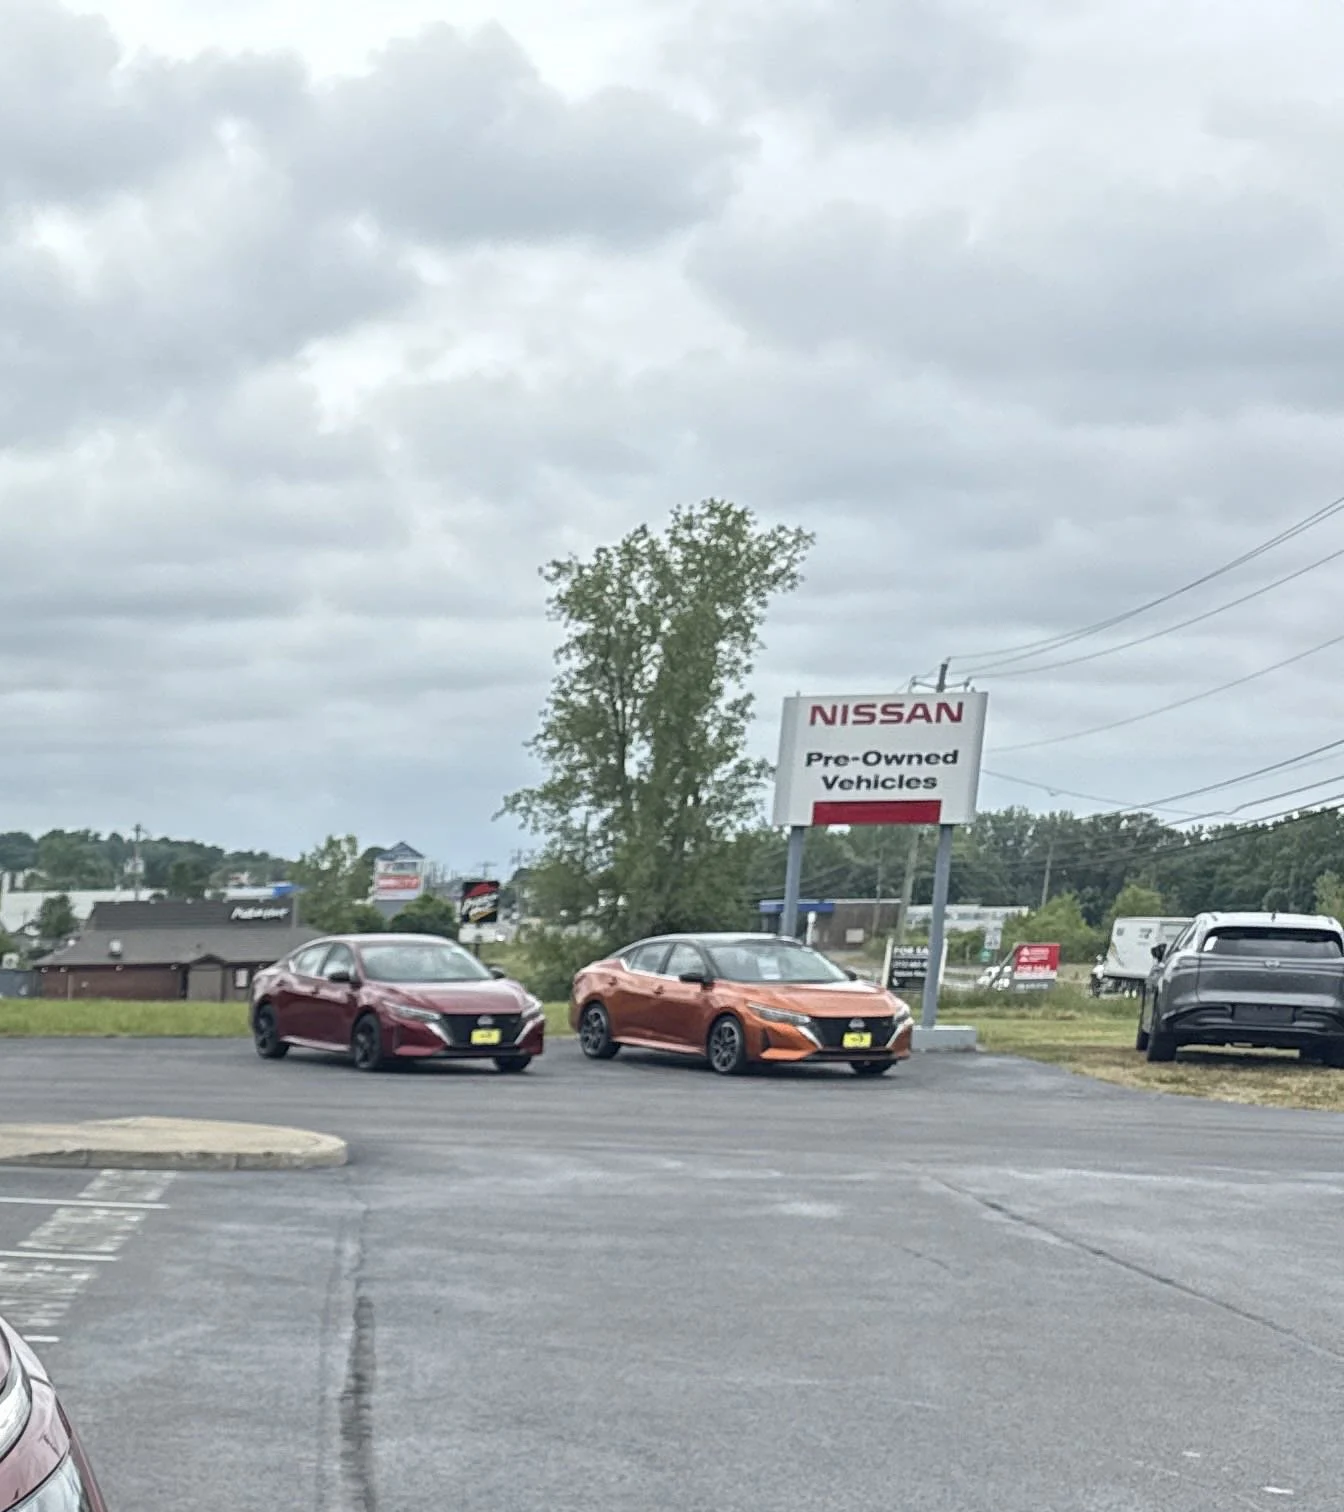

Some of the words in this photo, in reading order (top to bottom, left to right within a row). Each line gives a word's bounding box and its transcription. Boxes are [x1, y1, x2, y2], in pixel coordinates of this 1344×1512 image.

[809, 701, 964, 727] NISSAN
[804, 749, 960, 768] Pre-Owned
[821, 773, 938, 792] Vehicles
